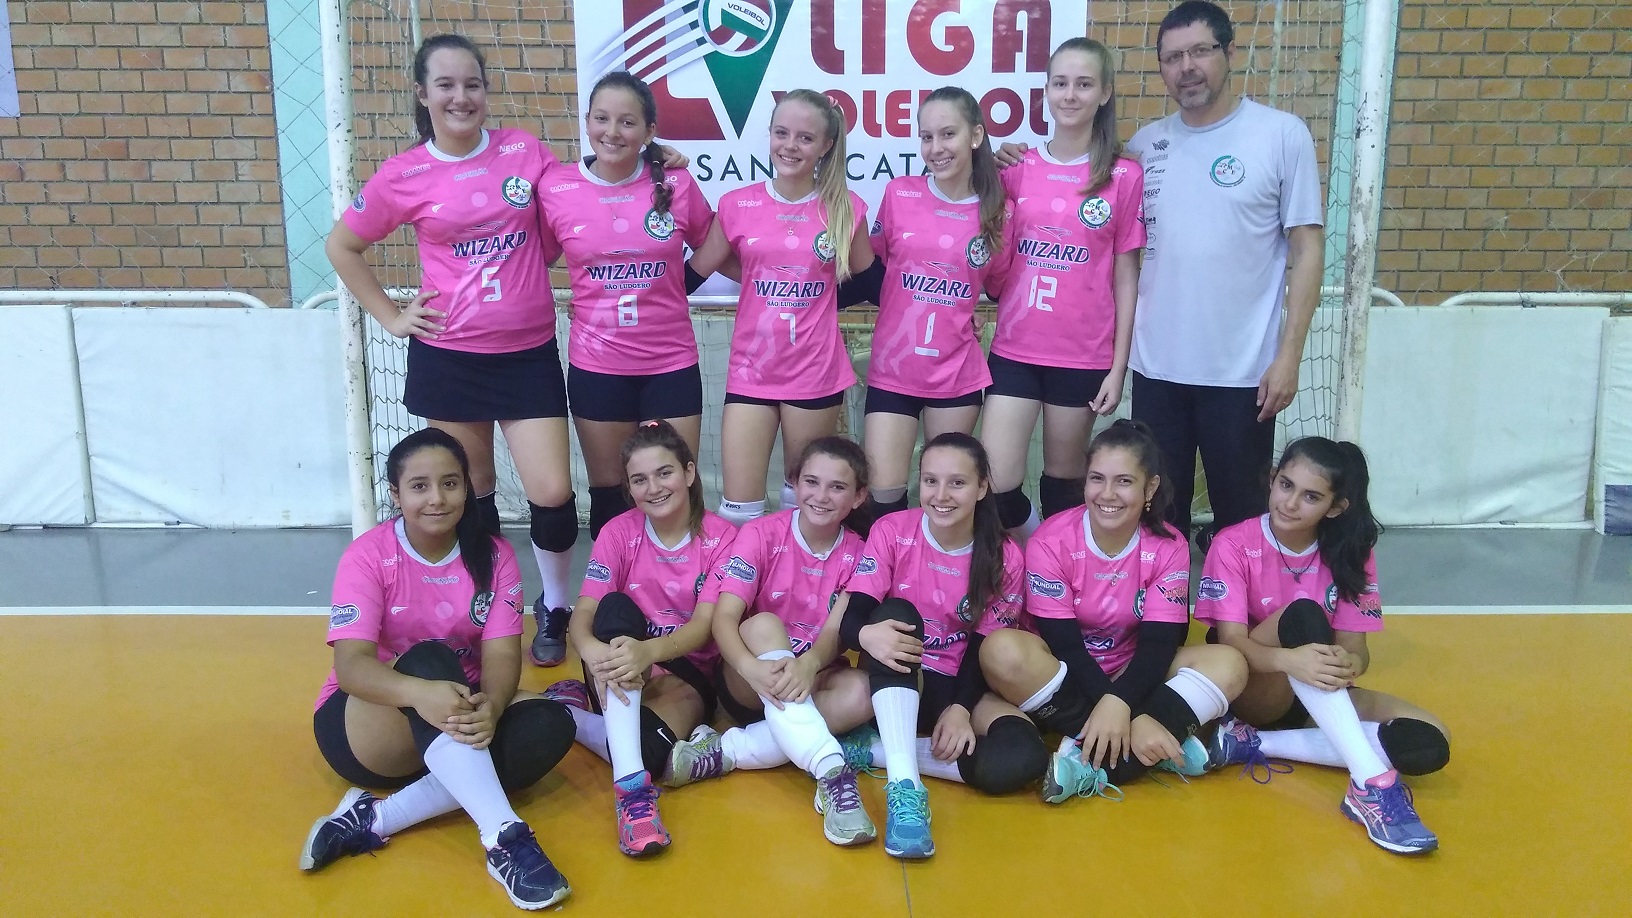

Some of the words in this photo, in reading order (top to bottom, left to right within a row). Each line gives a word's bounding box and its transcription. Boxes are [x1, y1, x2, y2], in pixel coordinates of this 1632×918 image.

[727, 2, 766, 26] VOLEIBOL
[810, 0, 1053, 76] LIGA
[498, 141, 526, 153] NEGO
[451, 230, 527, 257] WIZARD
[1018, 238, 1090, 264] WIZARD
[585, 261, 667, 282] WIZARD
[1026, 260, 1038, 268] SÃO
[1039, 262, 1071, 272] LUDGERO
[481, 266, 502, 302] 5
[604, 282, 618, 290] SÃO
[619, 282, 651, 290] LUDGERO
[753, 280, 825, 298] WIZARD
[1027, 275, 1058, 312] 12
[617, 294, 639, 327] 8
[766, 300, 779, 308] SÃO
[913, 294, 925, 302] SÃO
[926, 297, 957, 307] LUDGERO
[779, 312, 796, 346] 7
[914, 311, 940, 357] 1
[1034, 579, 1061, 590] MUNDIAL
